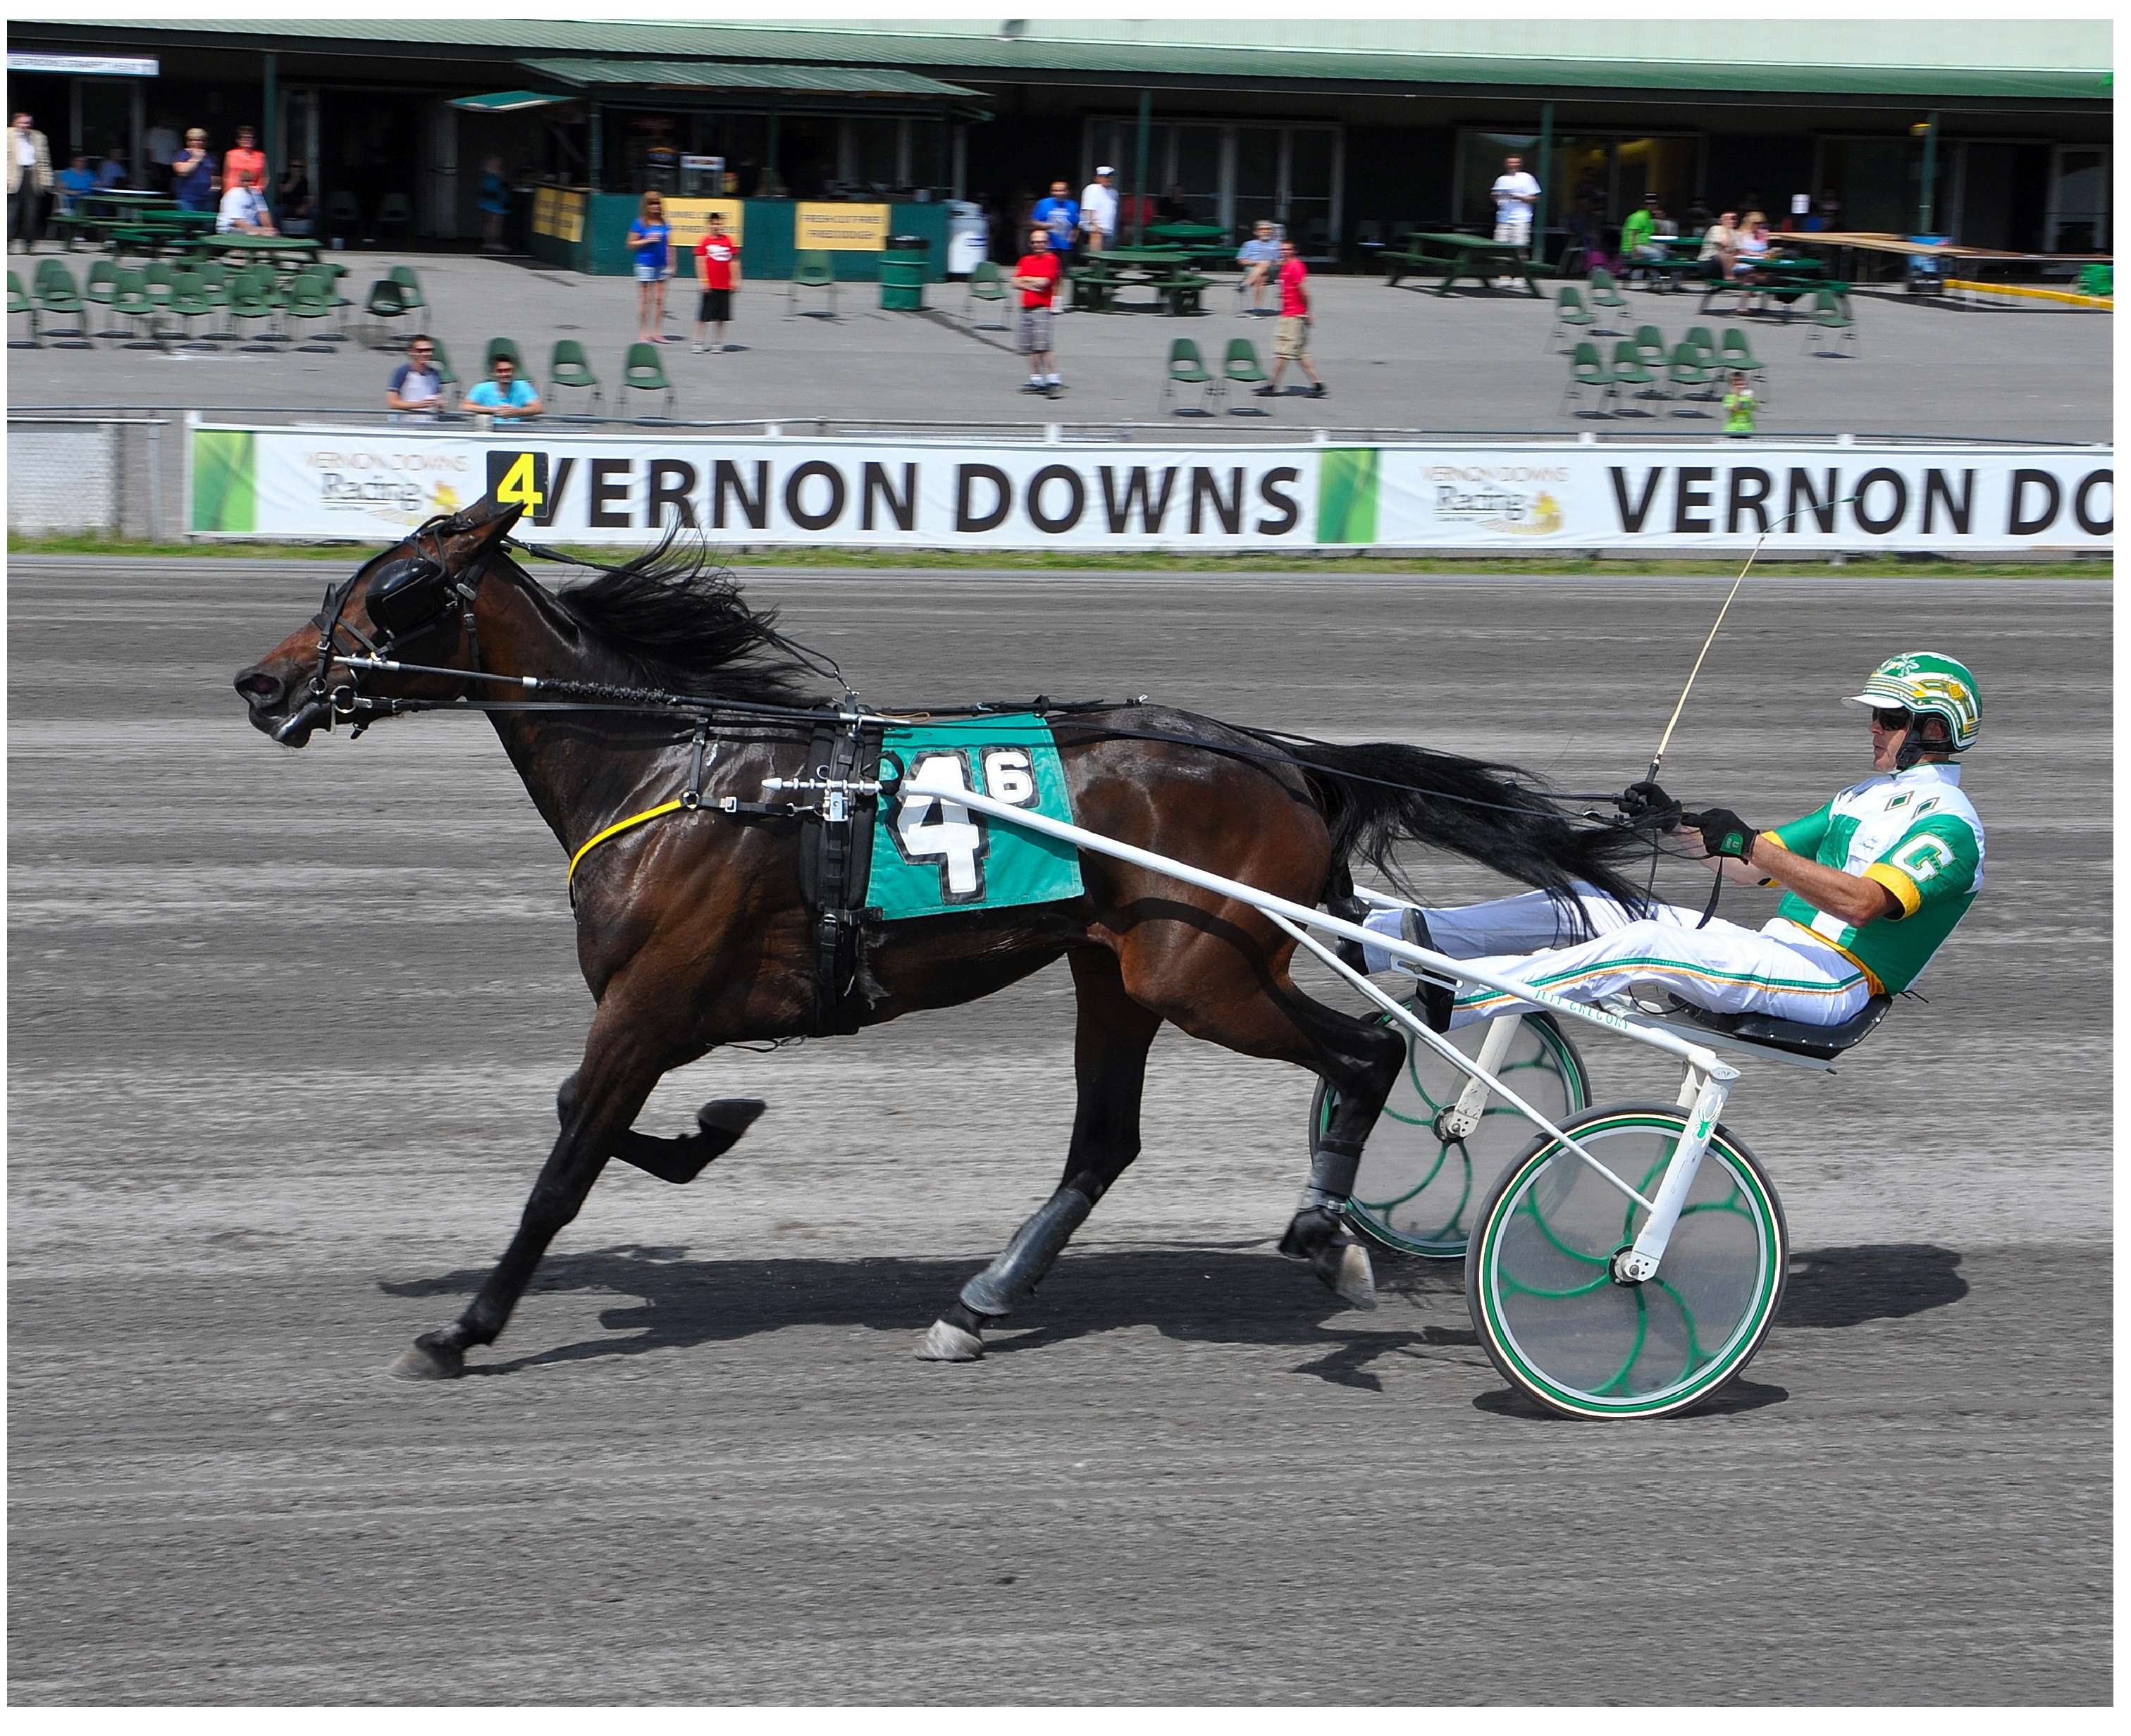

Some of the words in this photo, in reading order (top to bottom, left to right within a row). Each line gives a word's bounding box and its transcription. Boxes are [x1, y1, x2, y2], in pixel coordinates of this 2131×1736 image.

[306, 451, 386, 469] VERNON
[391, 453, 469, 472] DOWNS
[496, 452, 543, 516] 4
[321, 473, 423, 512] Racing
[954, 463, 1303, 536] DOWNS
[1433, 485, 1526, 521] Racing
[1605, 466, 1976, 535] VERNON
[889, 751, 987, 900] 4
[982, 749, 1037, 807] 6
[1533, 989, 1563, 1006] JEFF
[1569, 1002, 1631, 1030] GREGORY
